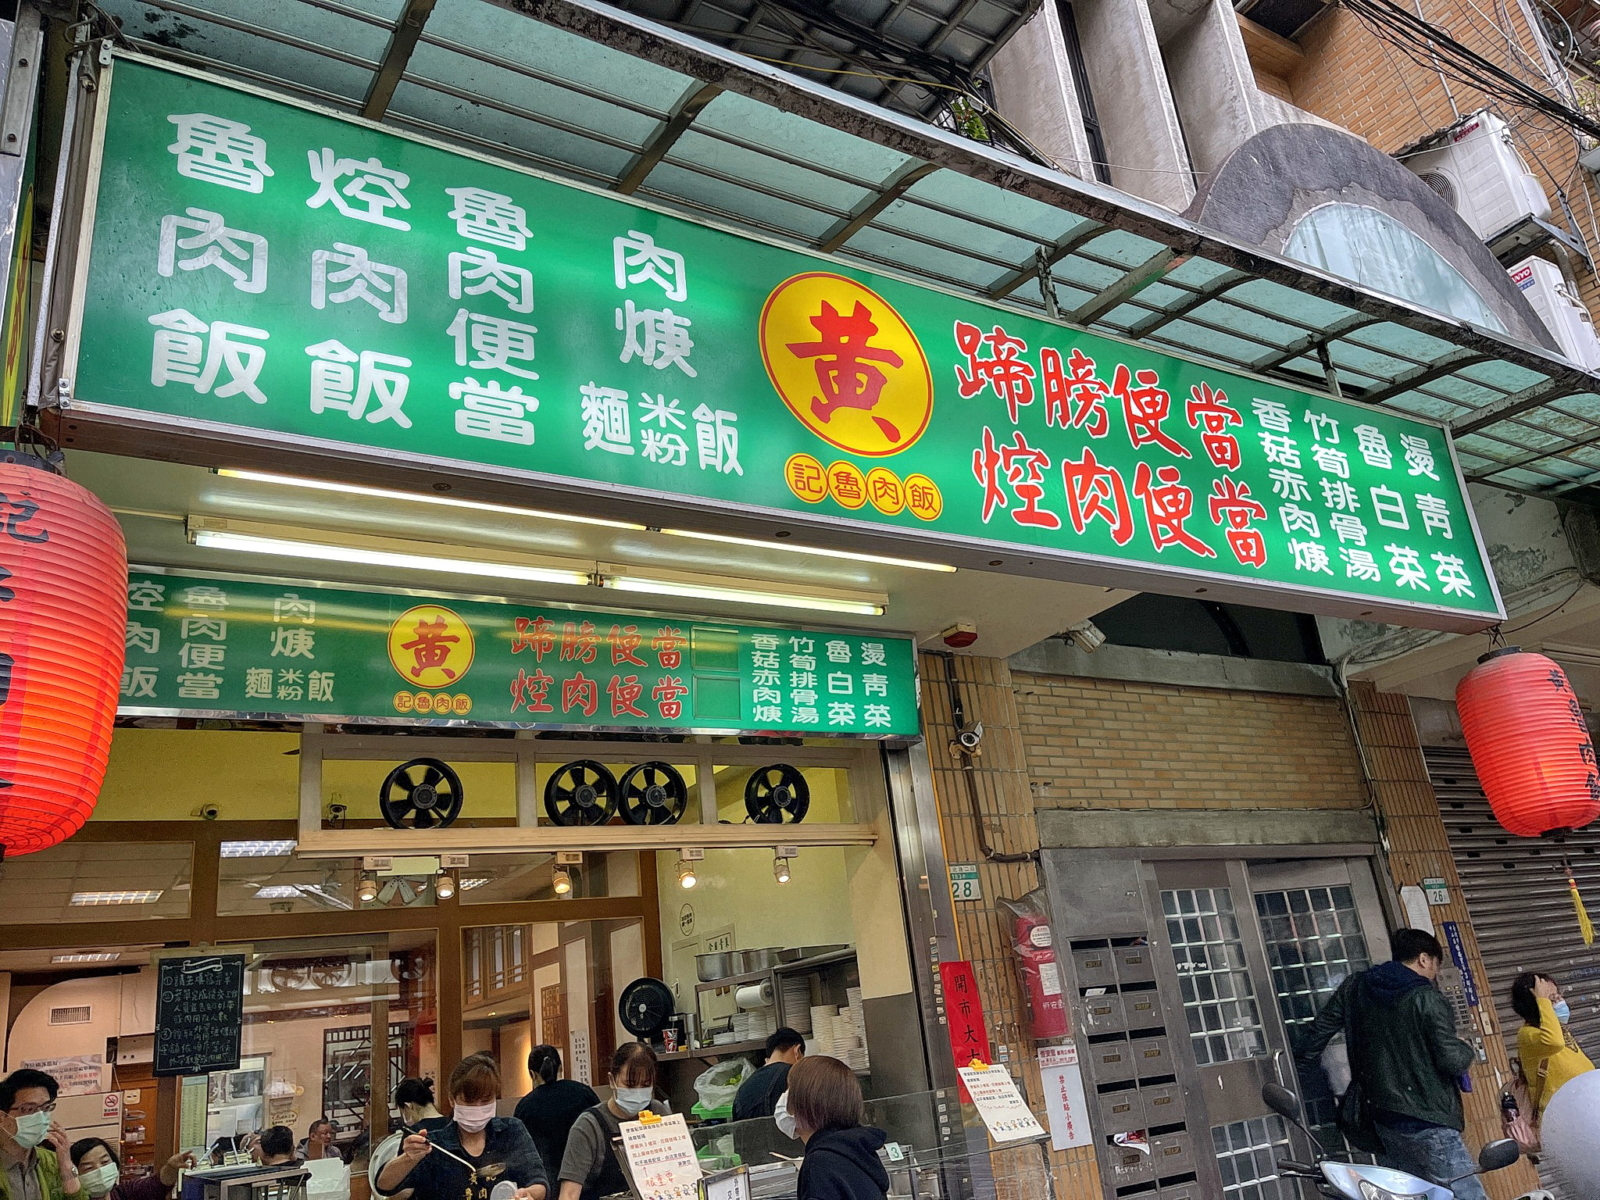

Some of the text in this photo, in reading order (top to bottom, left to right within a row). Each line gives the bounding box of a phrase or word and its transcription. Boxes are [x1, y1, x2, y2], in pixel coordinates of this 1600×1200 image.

[148, 112, 275, 405] 魯肉飯
[304, 147, 413, 429] 焢肉飯
[613, 229, 698, 378] 肉焿
[445, 186, 540, 446] 魯肉便當
[785, 299, 904, 443] 黃
[953, 319, 1244, 472] 蹄膀便當
[790, 461, 938, 513] 記魯肉飯
[971, 425, 1268, 569] 焢肉便當
[1250, 397, 1335, 577] 香菇赤肉焿
[1303, 409, 1383, 582] 竹筍排骨湯
[1353, 423, 1431, 592] 魯白菜
[1400, 432, 1476, 599] 燙青菜
[177, 585, 230, 700] 魯肉便當
[270, 593, 316, 660] 肉焿
[401, 614, 460, 679] 黃
[510, 615, 688, 669] 蹄膀便當
[397, 695, 470, 712] 記魯肉飯
[509, 668, 689, 719] 焢肉便當
[751, 633, 783, 724] 香菇赤肉焿
[788, 636, 820, 724] 竹筍排骨湯
[825, 640, 857, 727] 魯白菜
[861, 641, 892, 729] 燙青菜
[952, 881, 972, 898] 28
[1433, 890, 1444, 903] 26
[890, 1146, 900, 1159] 3
